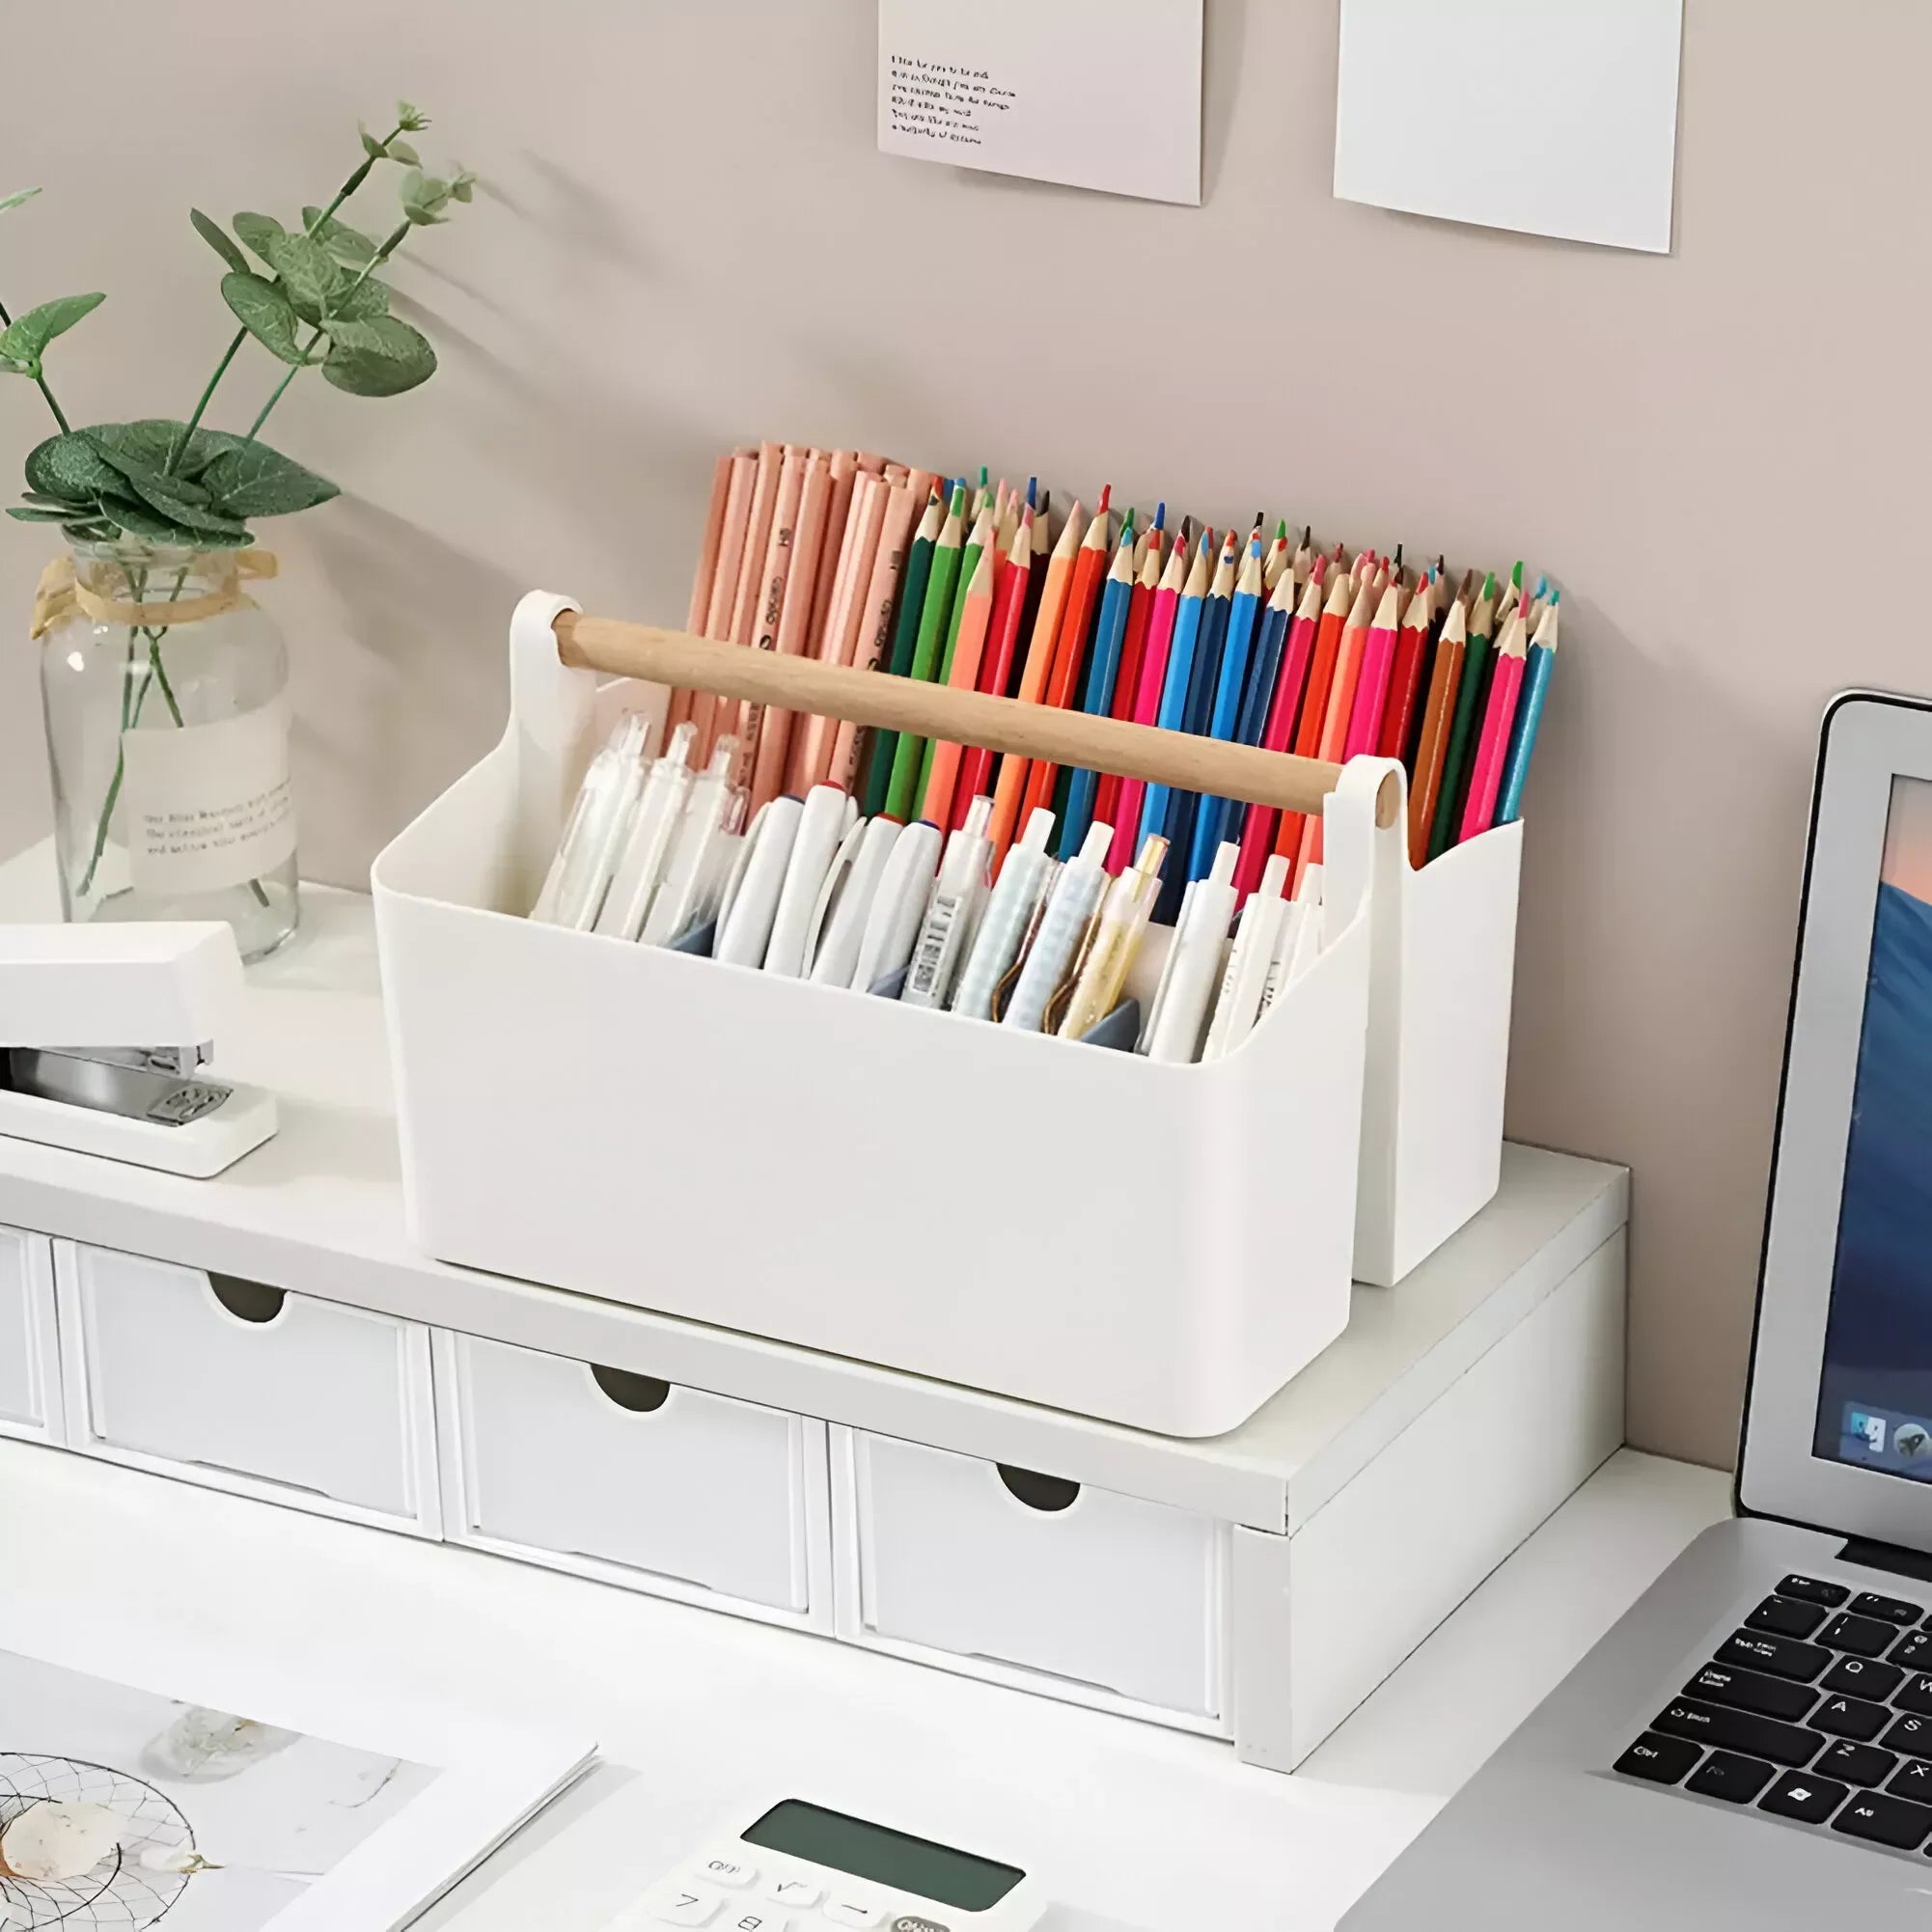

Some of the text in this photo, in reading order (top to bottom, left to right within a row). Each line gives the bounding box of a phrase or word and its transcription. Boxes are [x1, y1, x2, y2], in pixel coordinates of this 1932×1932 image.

[1831, 1700, 1846, 1712] A
[1903, 1719, 1922, 1731] S
[1910, 1764, 1930, 1778] X
